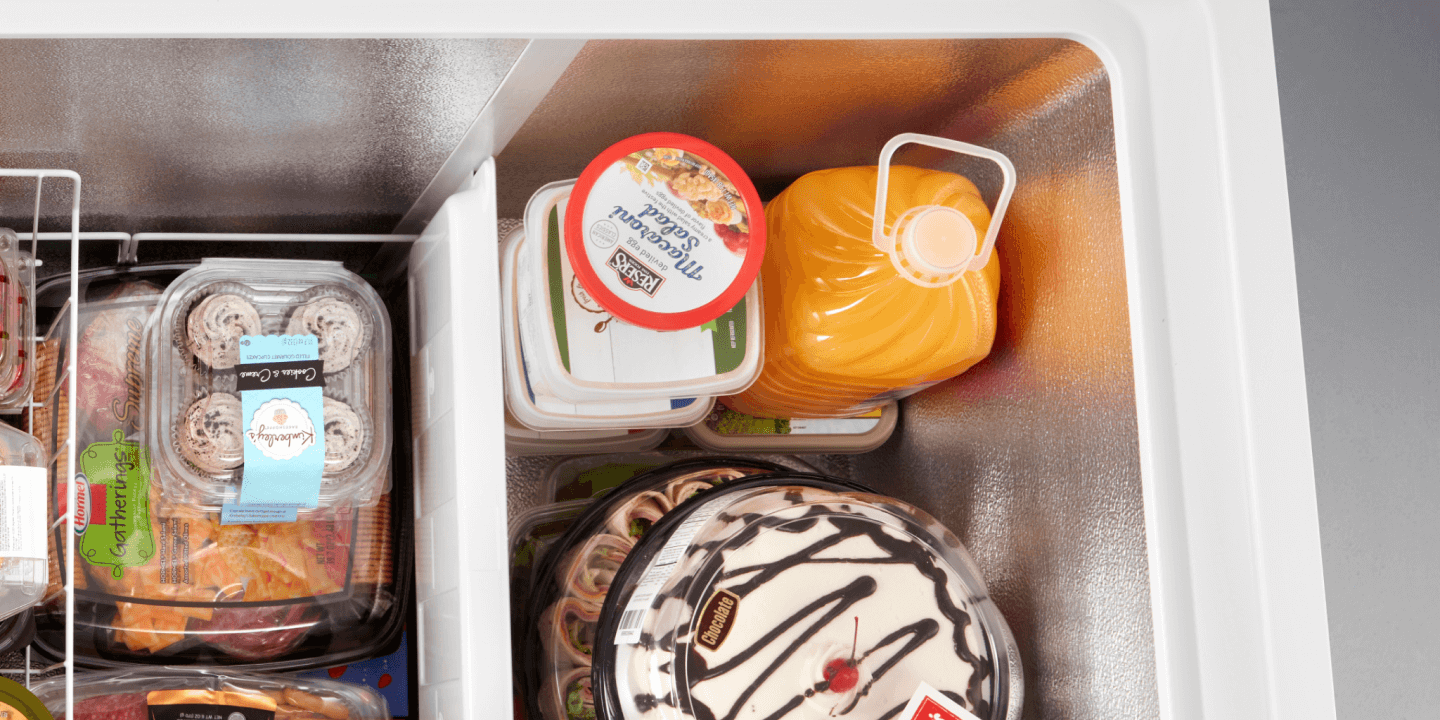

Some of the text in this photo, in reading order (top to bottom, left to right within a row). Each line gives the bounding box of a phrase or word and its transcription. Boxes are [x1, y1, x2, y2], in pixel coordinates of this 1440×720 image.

[641, 189, 659, 204] festive
[657, 201, 666, 210] the
[666, 207, 678, 219] with
[667, 198, 685, 215] deviled
[638, 203, 700, 252] Salad
[677, 215, 691, 229] salad
[691, 216, 706, 230] flavor
[592, 231, 614, 243] AMERICAN
[596, 224, 617, 238] CLASSICS
[691, 224, 709, 241] creamy
[608, 205, 703, 281] Macaroni
[626, 237, 668, 272] deviled egg
[611, 252, 660, 291] RESER'S
[112, 317, 142, 431] Supreme
[239, 367, 316, 382] Cookies & Creme
[248, 424, 314, 447] Kimberley's
[74, 481, 85, 527] Hormel
[109, 449, 134, 557] Gatherings
[701, 597, 734, 645] Chocolate
